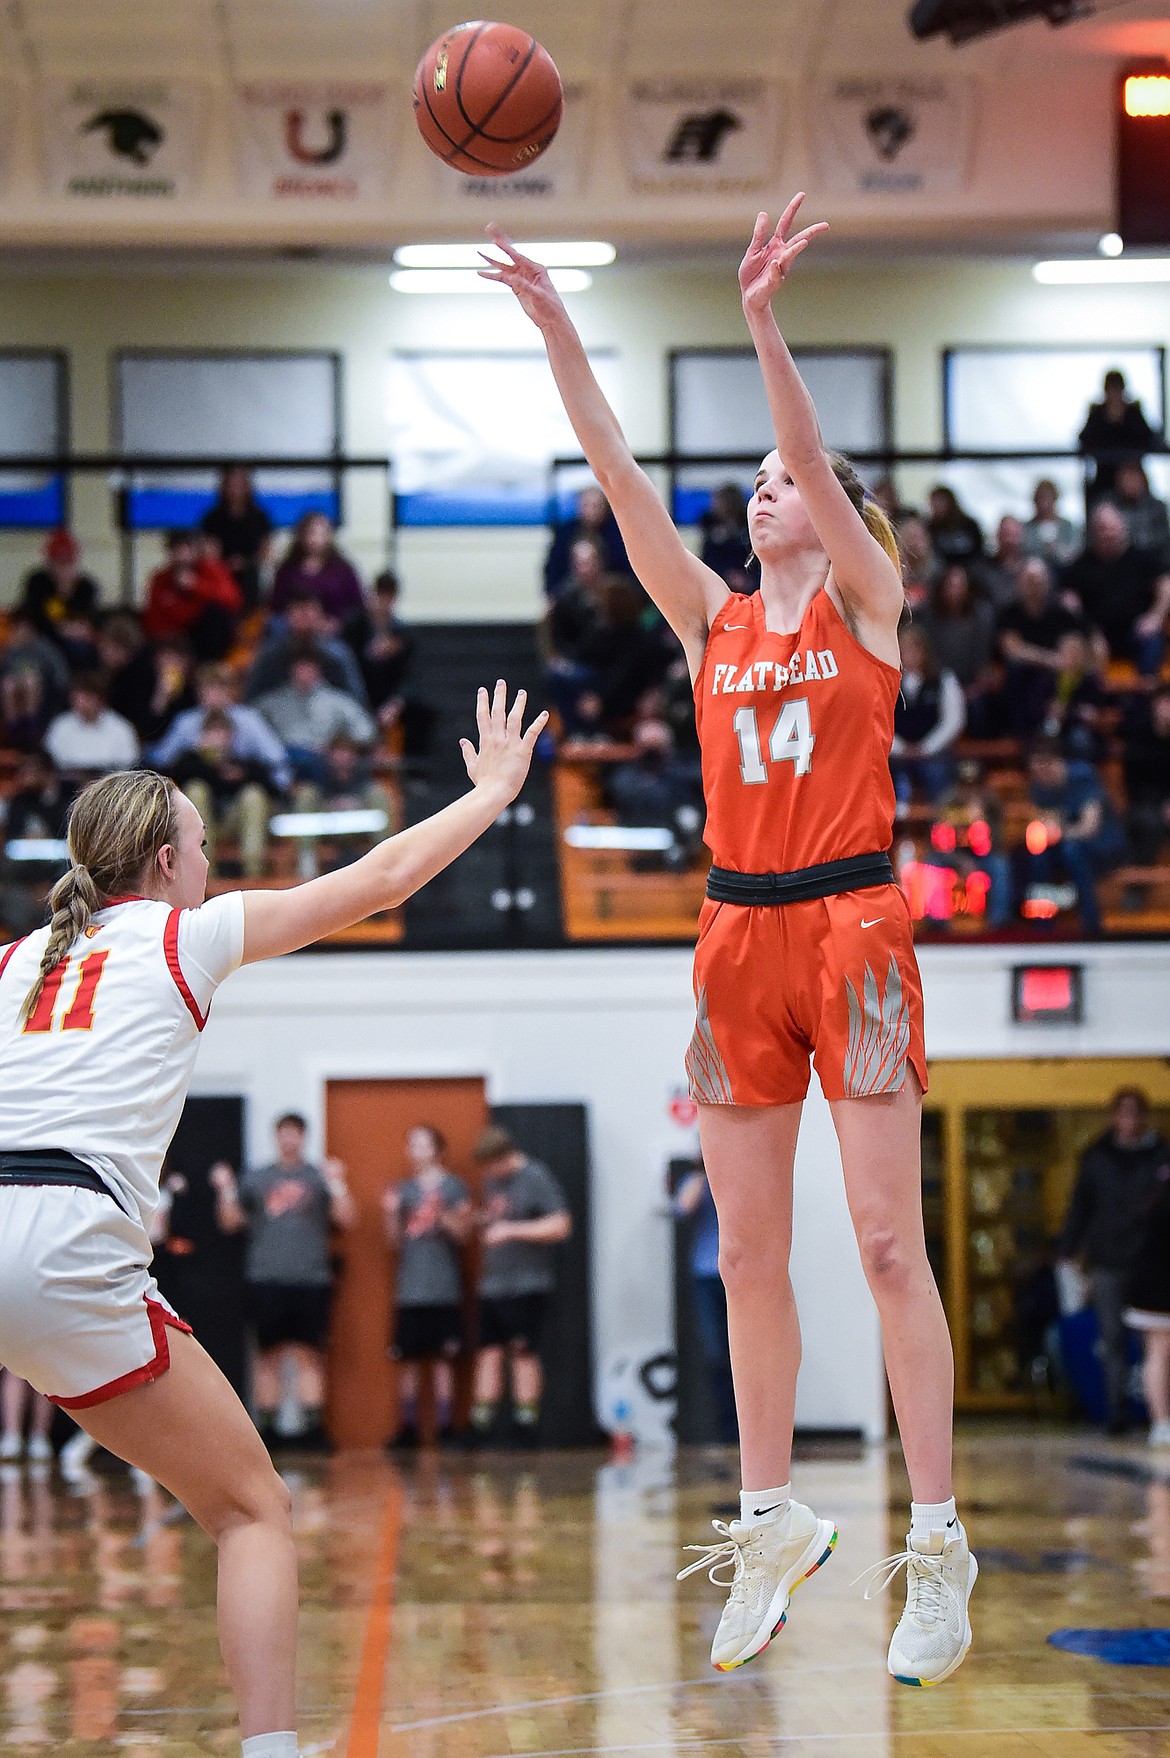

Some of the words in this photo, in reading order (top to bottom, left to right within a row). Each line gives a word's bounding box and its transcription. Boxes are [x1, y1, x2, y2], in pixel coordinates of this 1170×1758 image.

[711, 649, 839, 696] FLATHEAD
[733, 697, 816, 785] 14
[21, 948, 111, 1034] 11
